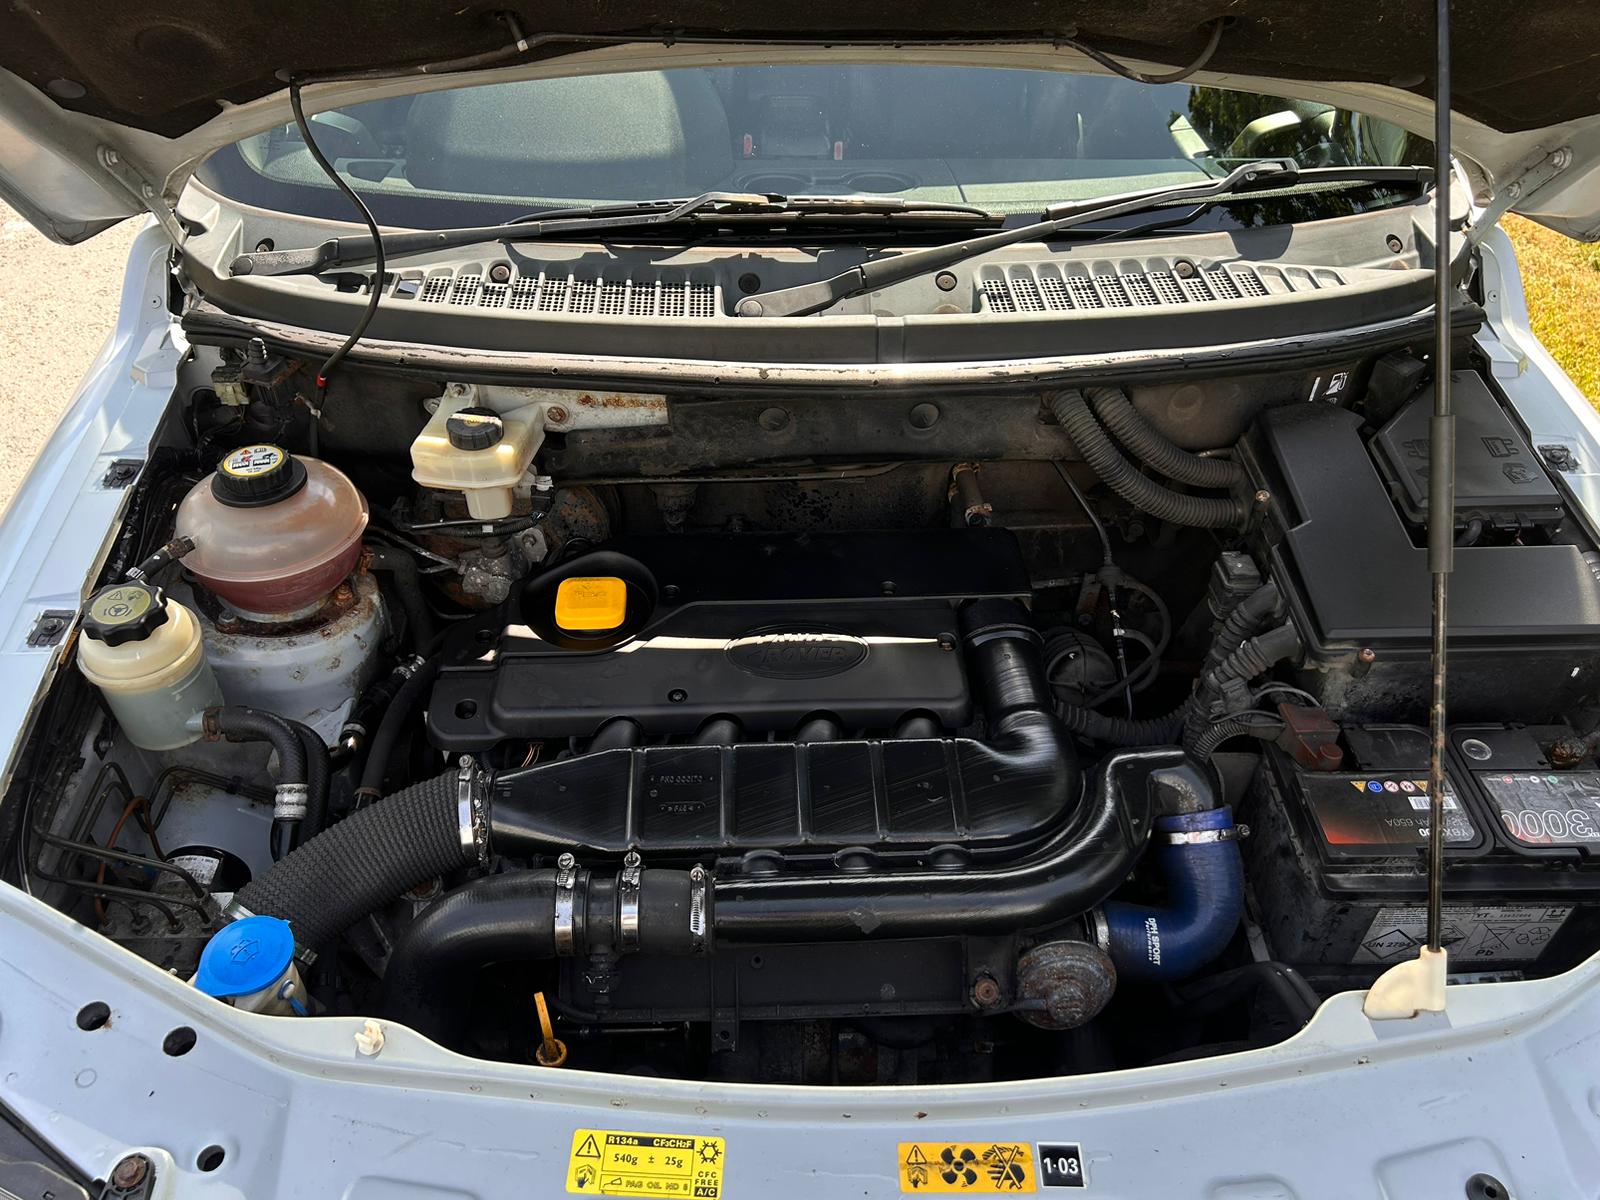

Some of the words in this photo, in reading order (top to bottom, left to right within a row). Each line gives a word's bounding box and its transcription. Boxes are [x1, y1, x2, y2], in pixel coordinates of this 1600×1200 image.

[1385, 818, 1414, 827] 650A
[1151, 935, 1161, 966] SPORT
[607, 1135, 639, 1145] R134a
[613, 1153, 638, 1166] 540g
[665, 1156, 683, 1168] 25g
[697, 1170, 717, 1178] CFC
[625, 1180, 644, 1188] PAG
[646, 1181, 662, 1189] OIL
[694, 1178, 719, 1187] FREE
[696, 1188, 716, 1197] A/C
